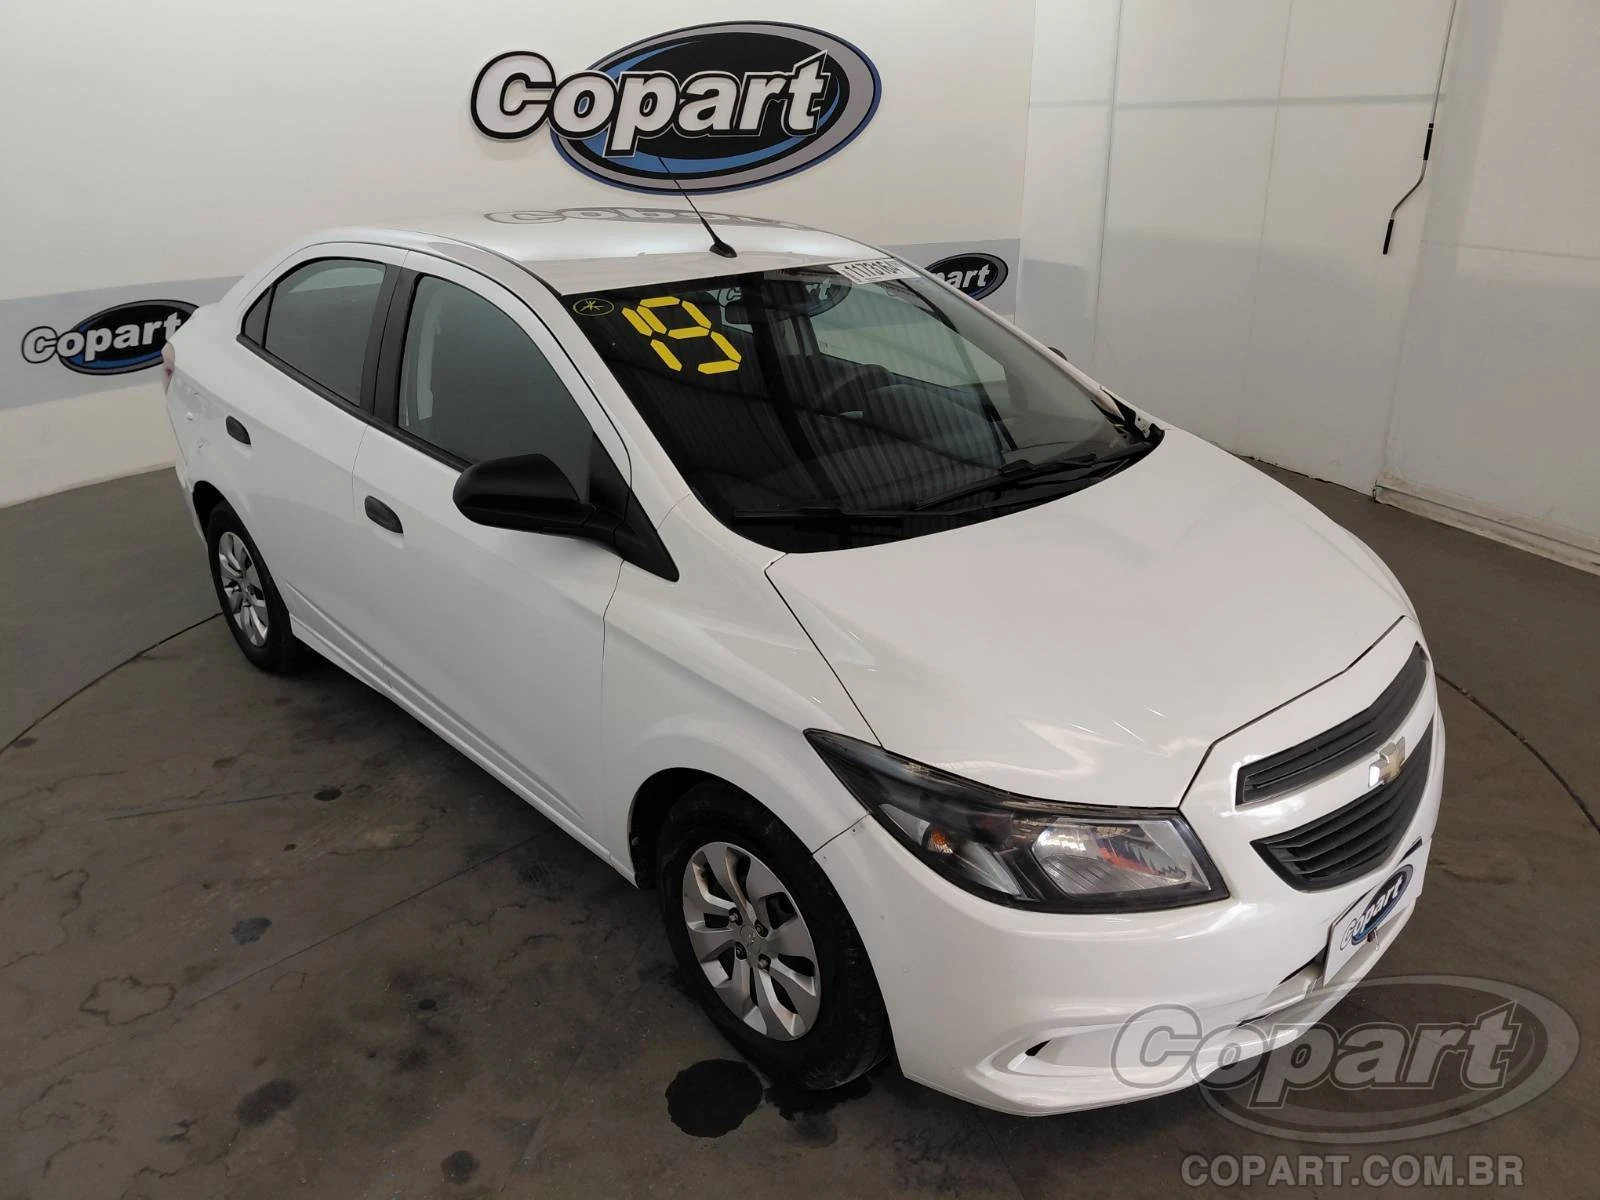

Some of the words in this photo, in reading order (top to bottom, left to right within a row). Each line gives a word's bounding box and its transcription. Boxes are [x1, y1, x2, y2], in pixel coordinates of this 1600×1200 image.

[470, 50, 831, 157] Copart
[935, 263, 991, 289] art
[21, 311, 182, 363] Copart
[1340, 875, 1404, 951] Copart
